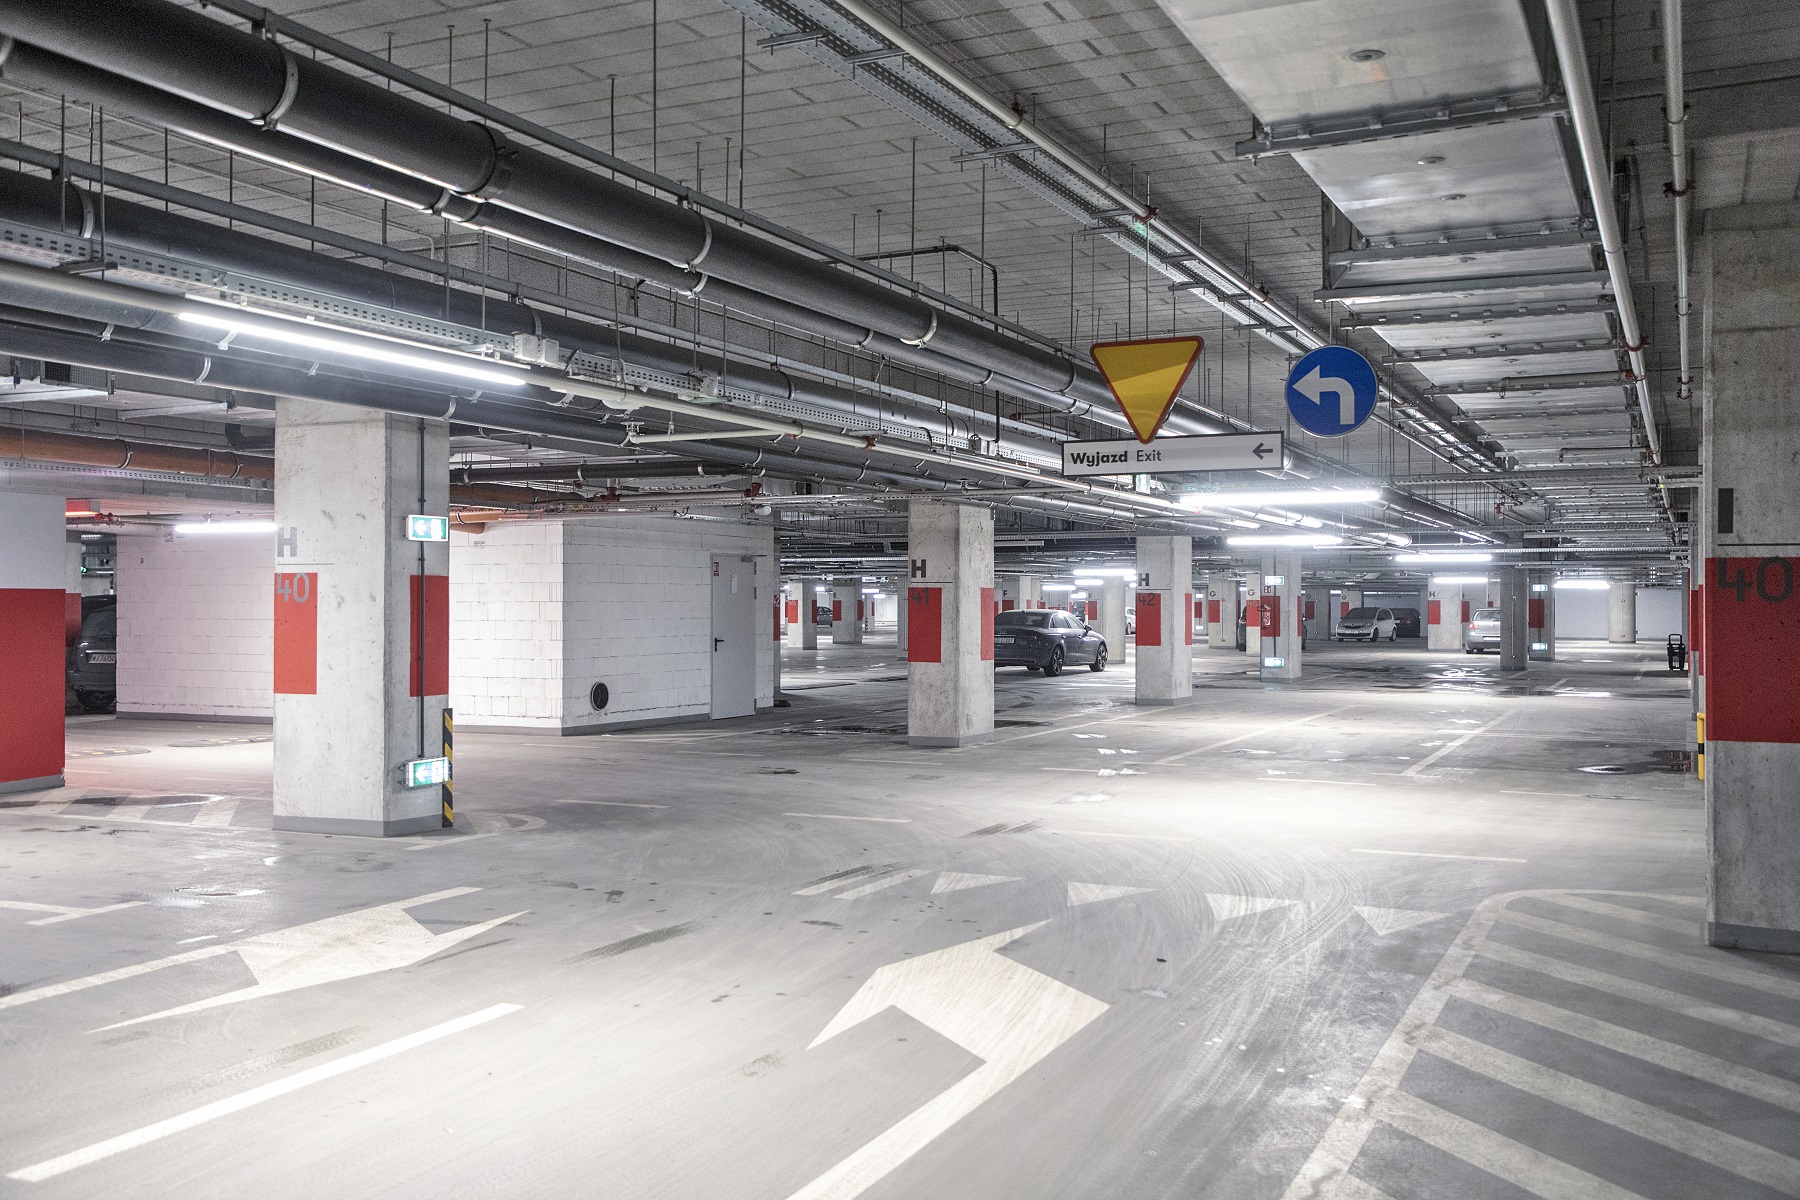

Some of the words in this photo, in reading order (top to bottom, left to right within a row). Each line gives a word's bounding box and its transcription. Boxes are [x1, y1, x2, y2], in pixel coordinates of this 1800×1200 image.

[1070, 450, 1128, 467] Wyjazd
[1136, 450, 1161, 462] Exit
[277, 527, 297, 557] H
[911, 559, 926, 578] H
[276, 572, 310, 602] 40
[1138, 572, 1149, 586] H
[1717, 556, 1794, 603] 40
[911, 586, 929, 605] 41
[1138, 593, 1155, 606] 42
[1247, 588, 1255, 596] G
